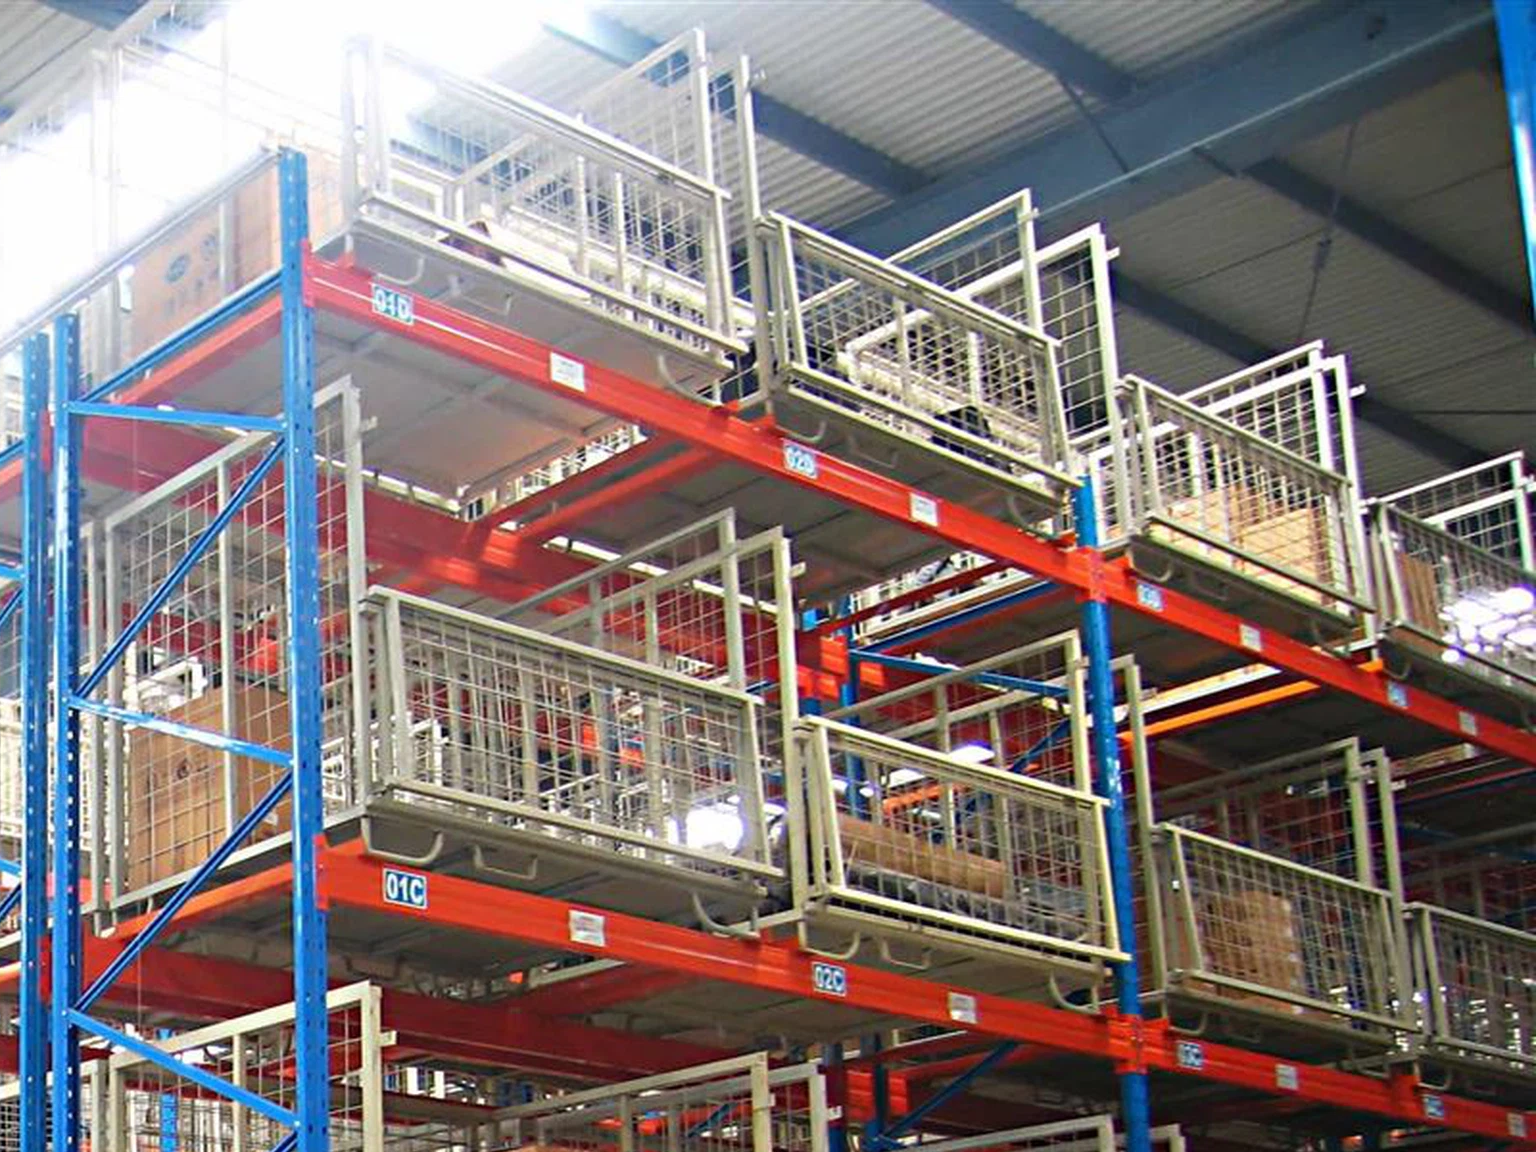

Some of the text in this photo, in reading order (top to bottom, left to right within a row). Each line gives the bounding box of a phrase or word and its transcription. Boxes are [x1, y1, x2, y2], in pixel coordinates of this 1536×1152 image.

[375, 288, 413, 322] 01D
[387, 873, 424, 904] 01C
[814, 966, 844, 991] 02C
